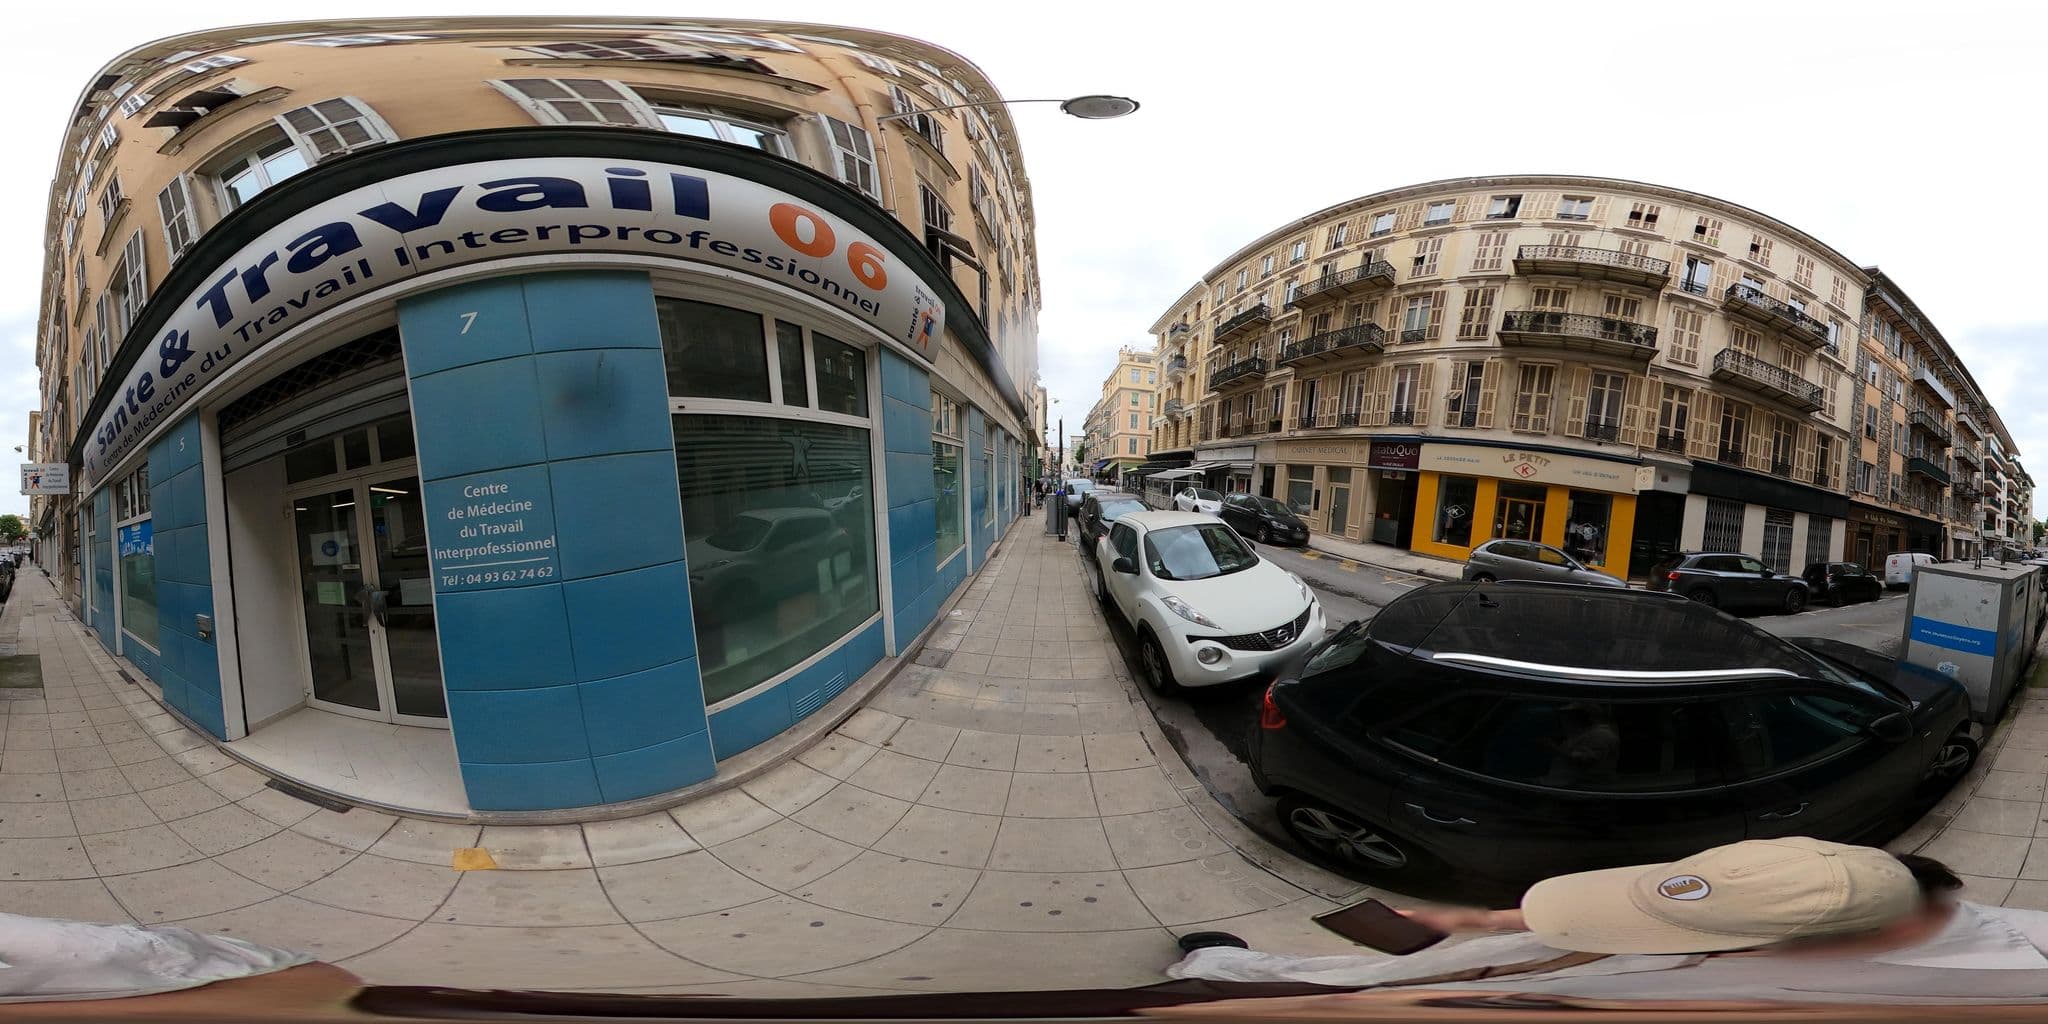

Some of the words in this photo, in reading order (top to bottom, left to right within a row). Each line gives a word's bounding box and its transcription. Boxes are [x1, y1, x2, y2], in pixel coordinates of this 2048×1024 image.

[159, 329, 196, 379] &
[196, 166, 710, 329] Travail
[769, 202, 888, 291] 06
[460, 311, 478, 335] 7
[103, 445, 122, 468] Centre
[123, 433, 133, 448] de
[133, 372, 197, 437] Médecine
[200, 342, 232, 373] du
[233, 258, 373, 342] Travail
[394, 224, 881, 317] Interprofessionnel
[179, 436, 185, 452] 5
[1502, 453, 1515, 464] LE
[1519, 452, 1551, 467] PETIT
[1521, 466, 1529, 474] K
[464, 483, 508, 498] Centre
[447, 507, 464, 520] de
[467, 500, 533, 518] Médecine
[460, 526, 477, 538] du
[479, 519, 524, 536] Travail
[435, 535, 556, 560] Interprofessionnel
[441, 574, 458, 587] Tél
[466, 574, 482, 584] 04
[484, 572, 499, 582] 93
[502, 570, 516, 581] 62
[520, 568, 535, 579] 74
[537, 566, 553, 577] 62
